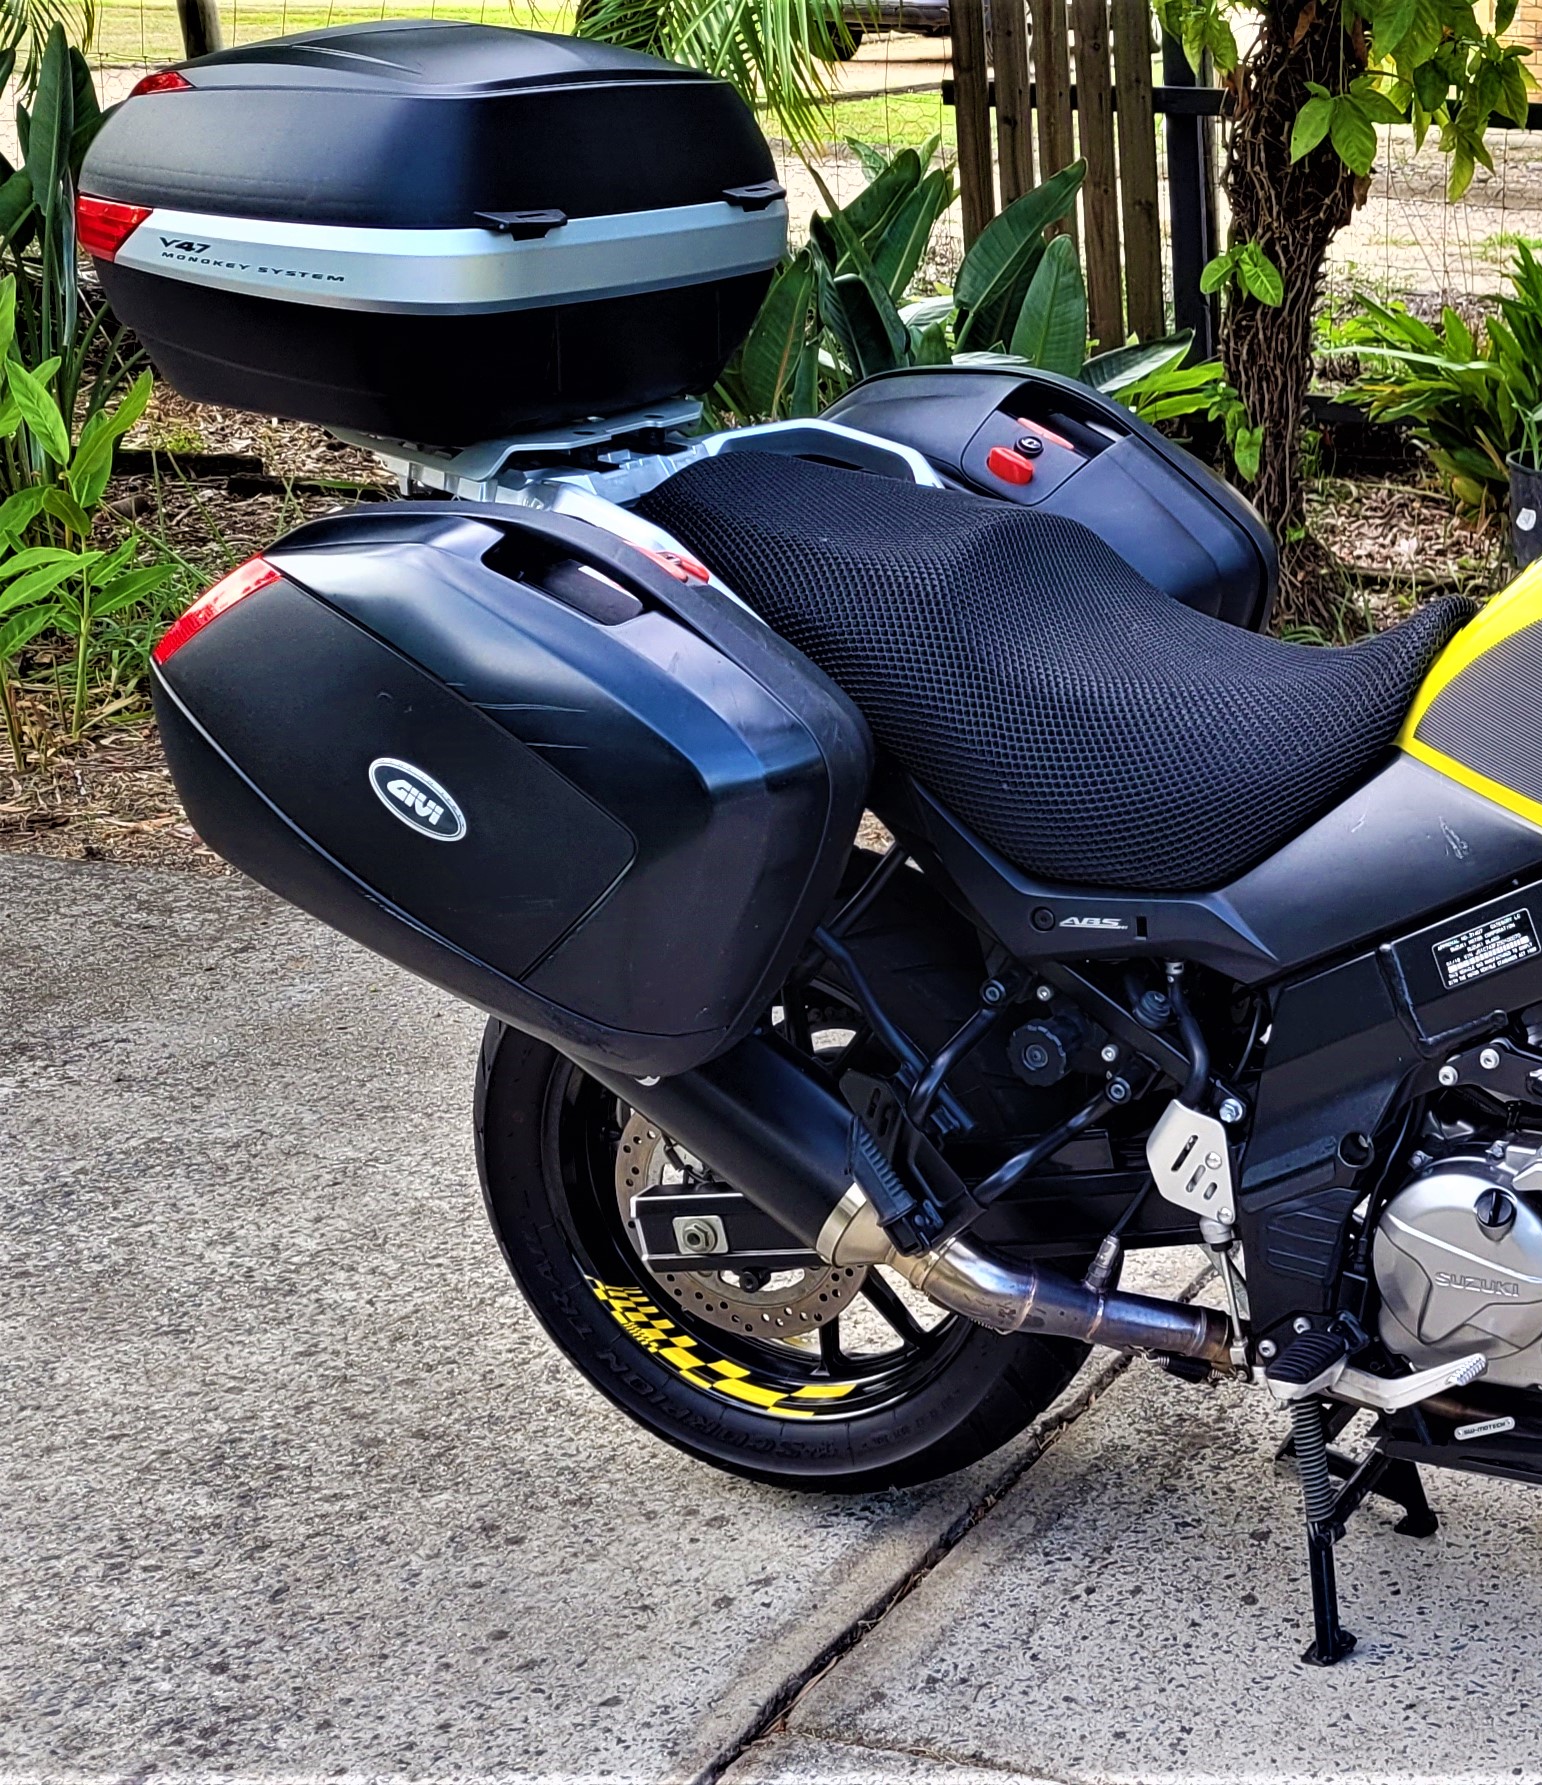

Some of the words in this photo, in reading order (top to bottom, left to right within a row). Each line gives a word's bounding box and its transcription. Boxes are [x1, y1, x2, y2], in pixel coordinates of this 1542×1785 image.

[159, 236, 211, 254] V47
[162, 252, 251, 270] MONOKEY
[257, 266, 346, 283] SYSTEM
[386, 779, 445, 826] GIVI
[1059, 916, 1124, 928] ABS
[1434, 1271, 1520, 1298] SUZUKI
